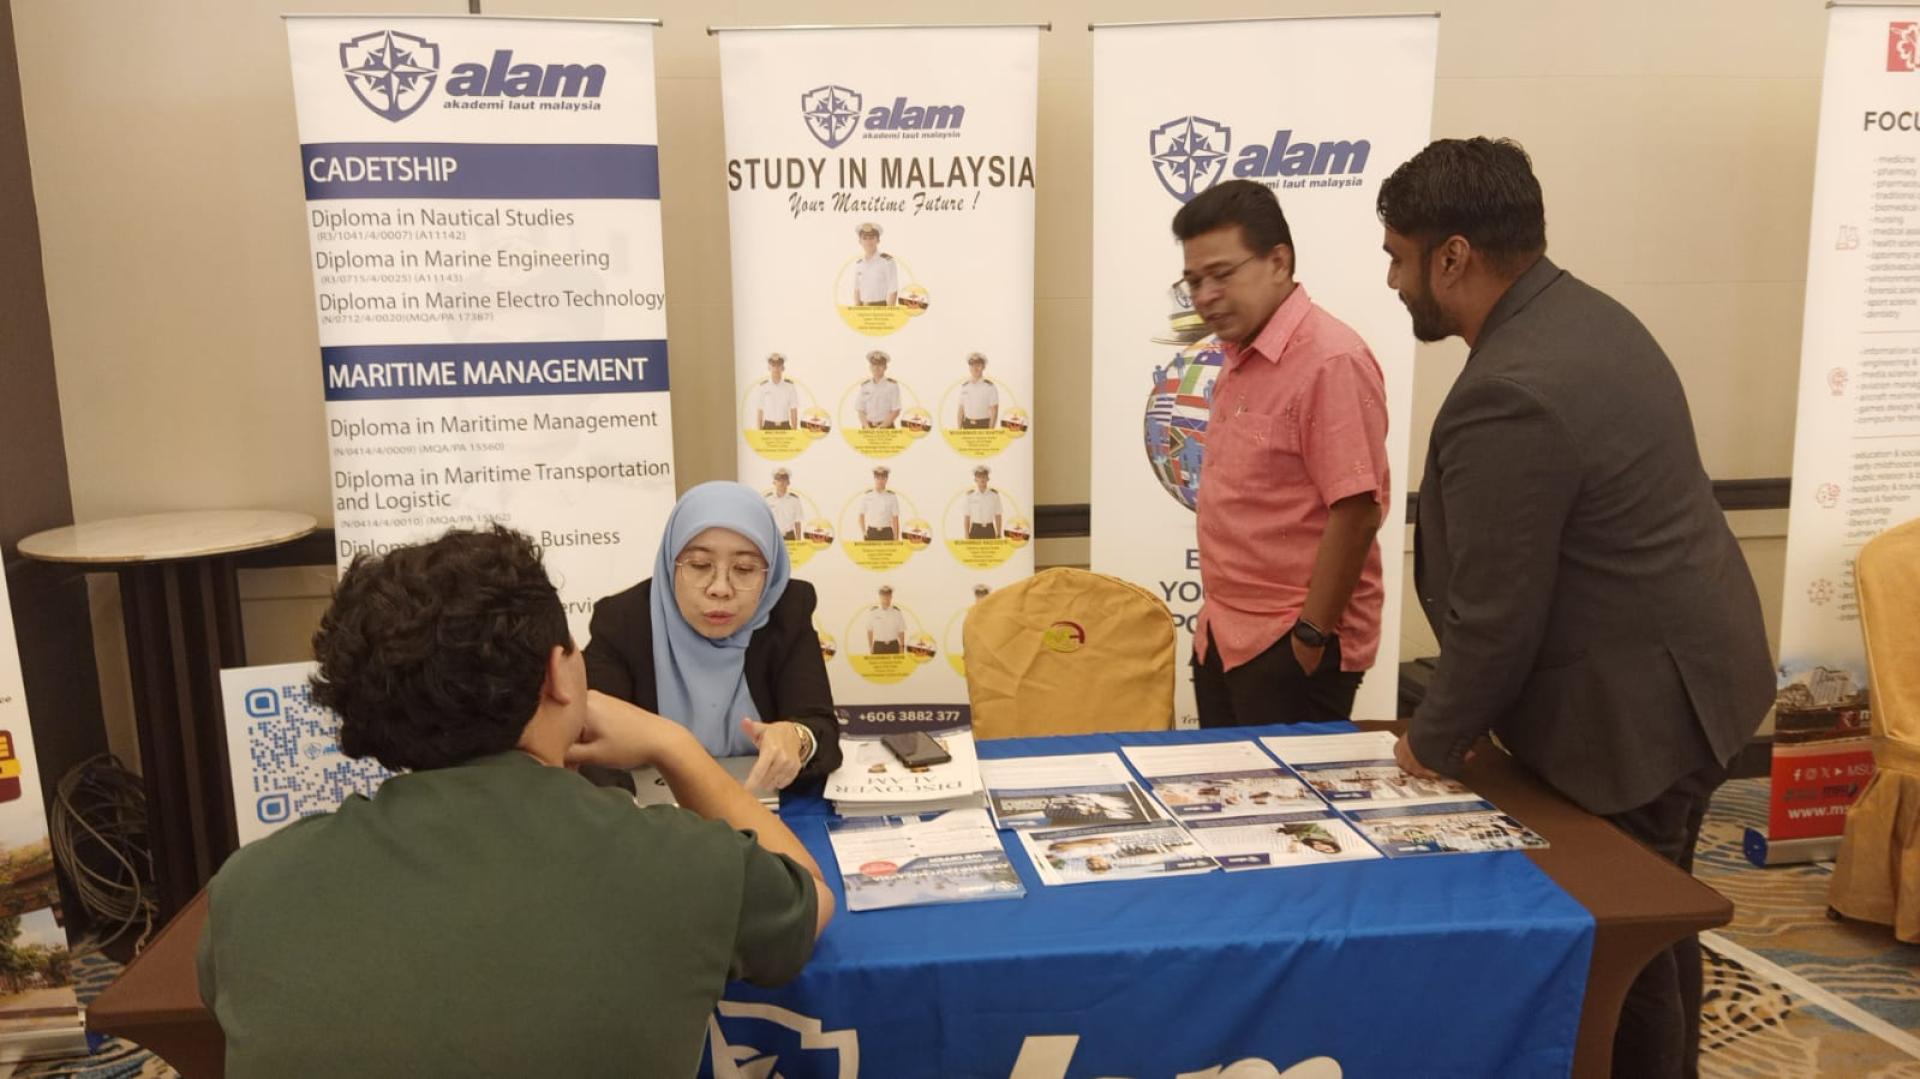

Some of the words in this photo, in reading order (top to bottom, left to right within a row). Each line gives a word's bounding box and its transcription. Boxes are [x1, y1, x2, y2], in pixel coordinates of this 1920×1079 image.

[445, 49, 607, 97] alam
[443, 100, 504, 110] akademi
[508, 100, 536, 110] laut
[539, 100, 602, 111] malaysia
[864, 96, 965, 130] alam
[1863, 110, 1920, 131] FOCU
[1232, 129, 1371, 178] alam
[309, 157, 458, 183] CADETSHIP
[728, 157, 827, 191] STUDY
[839, 157, 867, 189] IN
[880, 155, 1035, 189] MALAYSIA
[1282, 180, 1306, 189] laut
[1309, 177, 1363, 189] malaysia
[789, 191, 825, 219] Your
[831, 191, 906, 213] Maritime
[912, 191, 965, 216] Future
[312, 209, 391, 231] Diploma
[398, 210, 415, 226] in
[421, 208, 500, 226] Nautical
[505, 208, 575, 226] Studies
[316, 250, 395, 271] Diploma
[401, 249, 419, 267] in
[425, 250, 492, 267] Marine
[497, 249, 610, 271] Engineering
[320, 293, 396, 314] Diploma
[402, 292, 419, 309] in
[426, 292, 491, 309] Marine
[497, 290, 560, 307] Electro
[563, 289, 665, 310] Technology
[328, 361, 456, 389] MARITIME
[463, 357, 648, 384] MANAGEMENT
[331, 419, 411, 440] Diploma
[417, 417, 434, 434] in
[441, 413, 528, 433] Maritime
[533, 411, 658, 433] Management
[335, 471, 414, 491] Diploma
[421, 469, 438, 485] in
[445, 466, 531, 485] Maritime
[536, 460, 670, 482] Transportation
[337, 493, 369, 511] and
[376, 490, 452, 513] Logistic
[541, 529, 621, 547] Business
[859, 710, 896, 722] +606
[897, 710, 934, 721] 3882
[936, 710, 961, 721] 377
